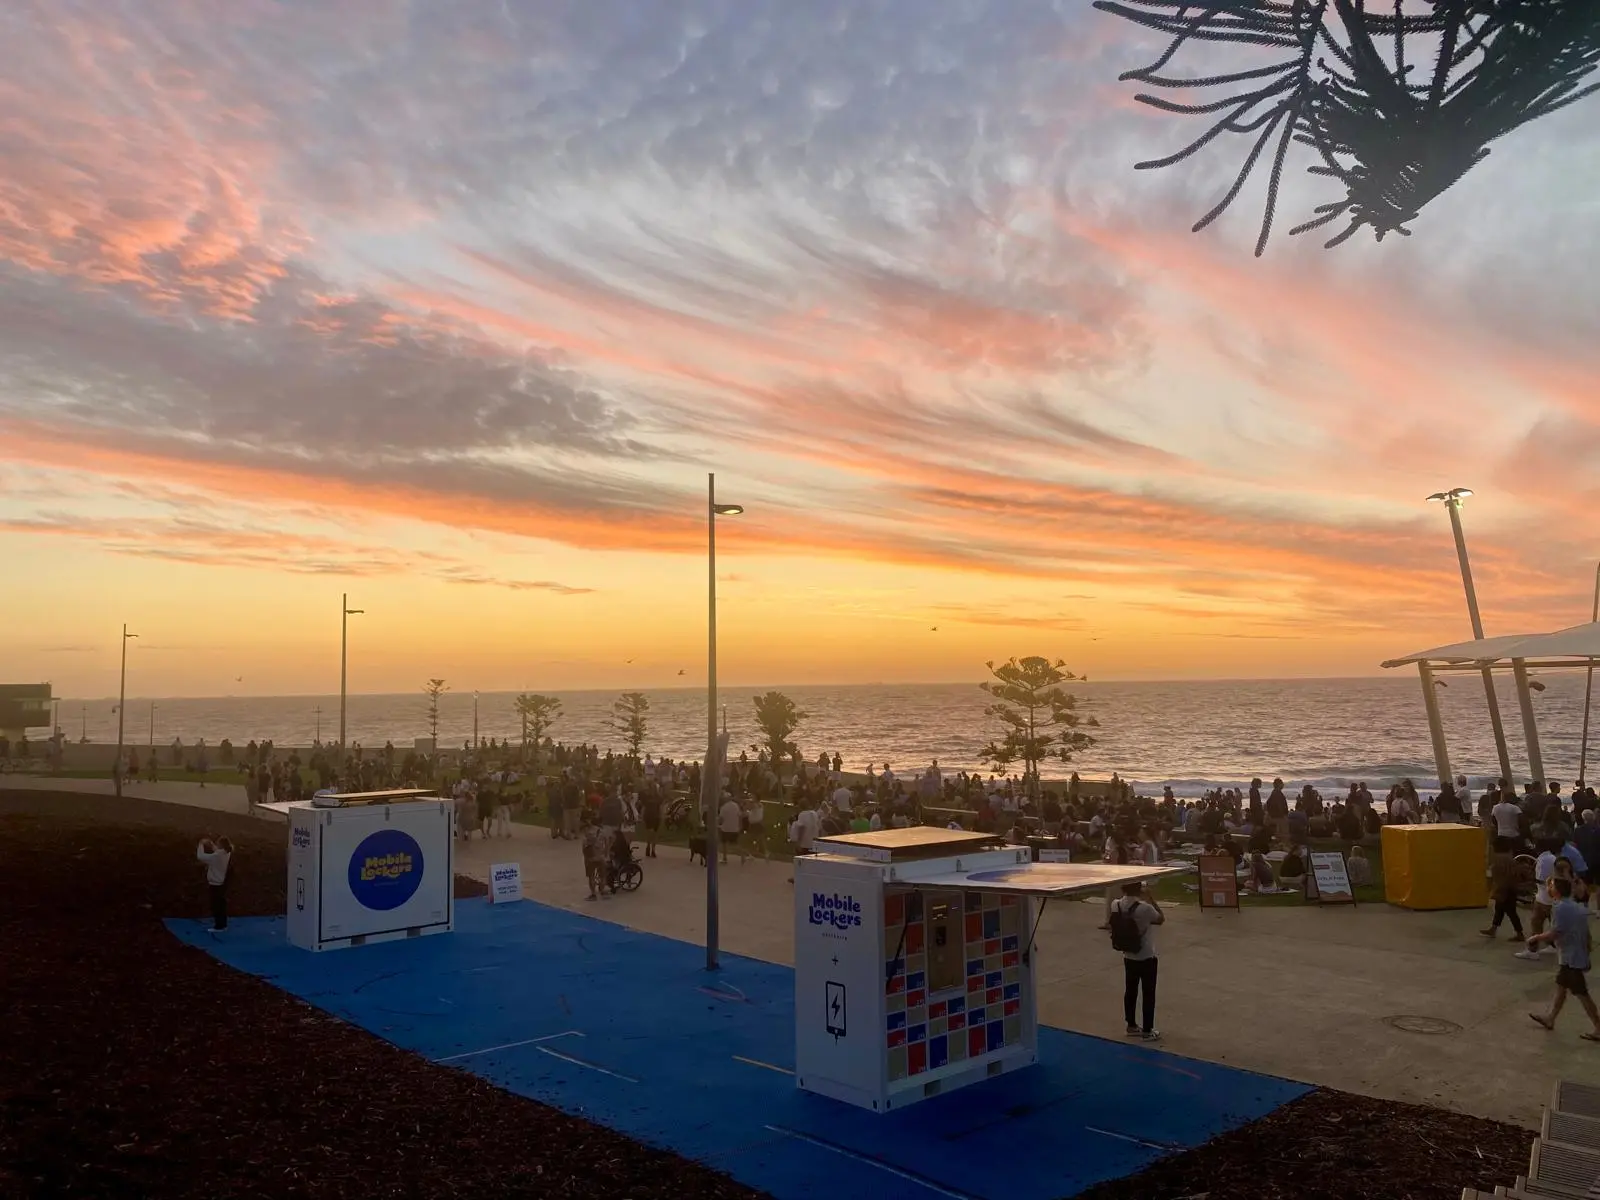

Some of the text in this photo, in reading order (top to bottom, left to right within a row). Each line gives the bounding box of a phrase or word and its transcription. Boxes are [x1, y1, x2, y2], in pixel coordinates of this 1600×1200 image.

[365, 852, 412, 868] Mobile
[360, 864, 413, 881] Lockers
[813, 893, 861, 912] Mobile
[809, 906, 861, 929] Lockers
